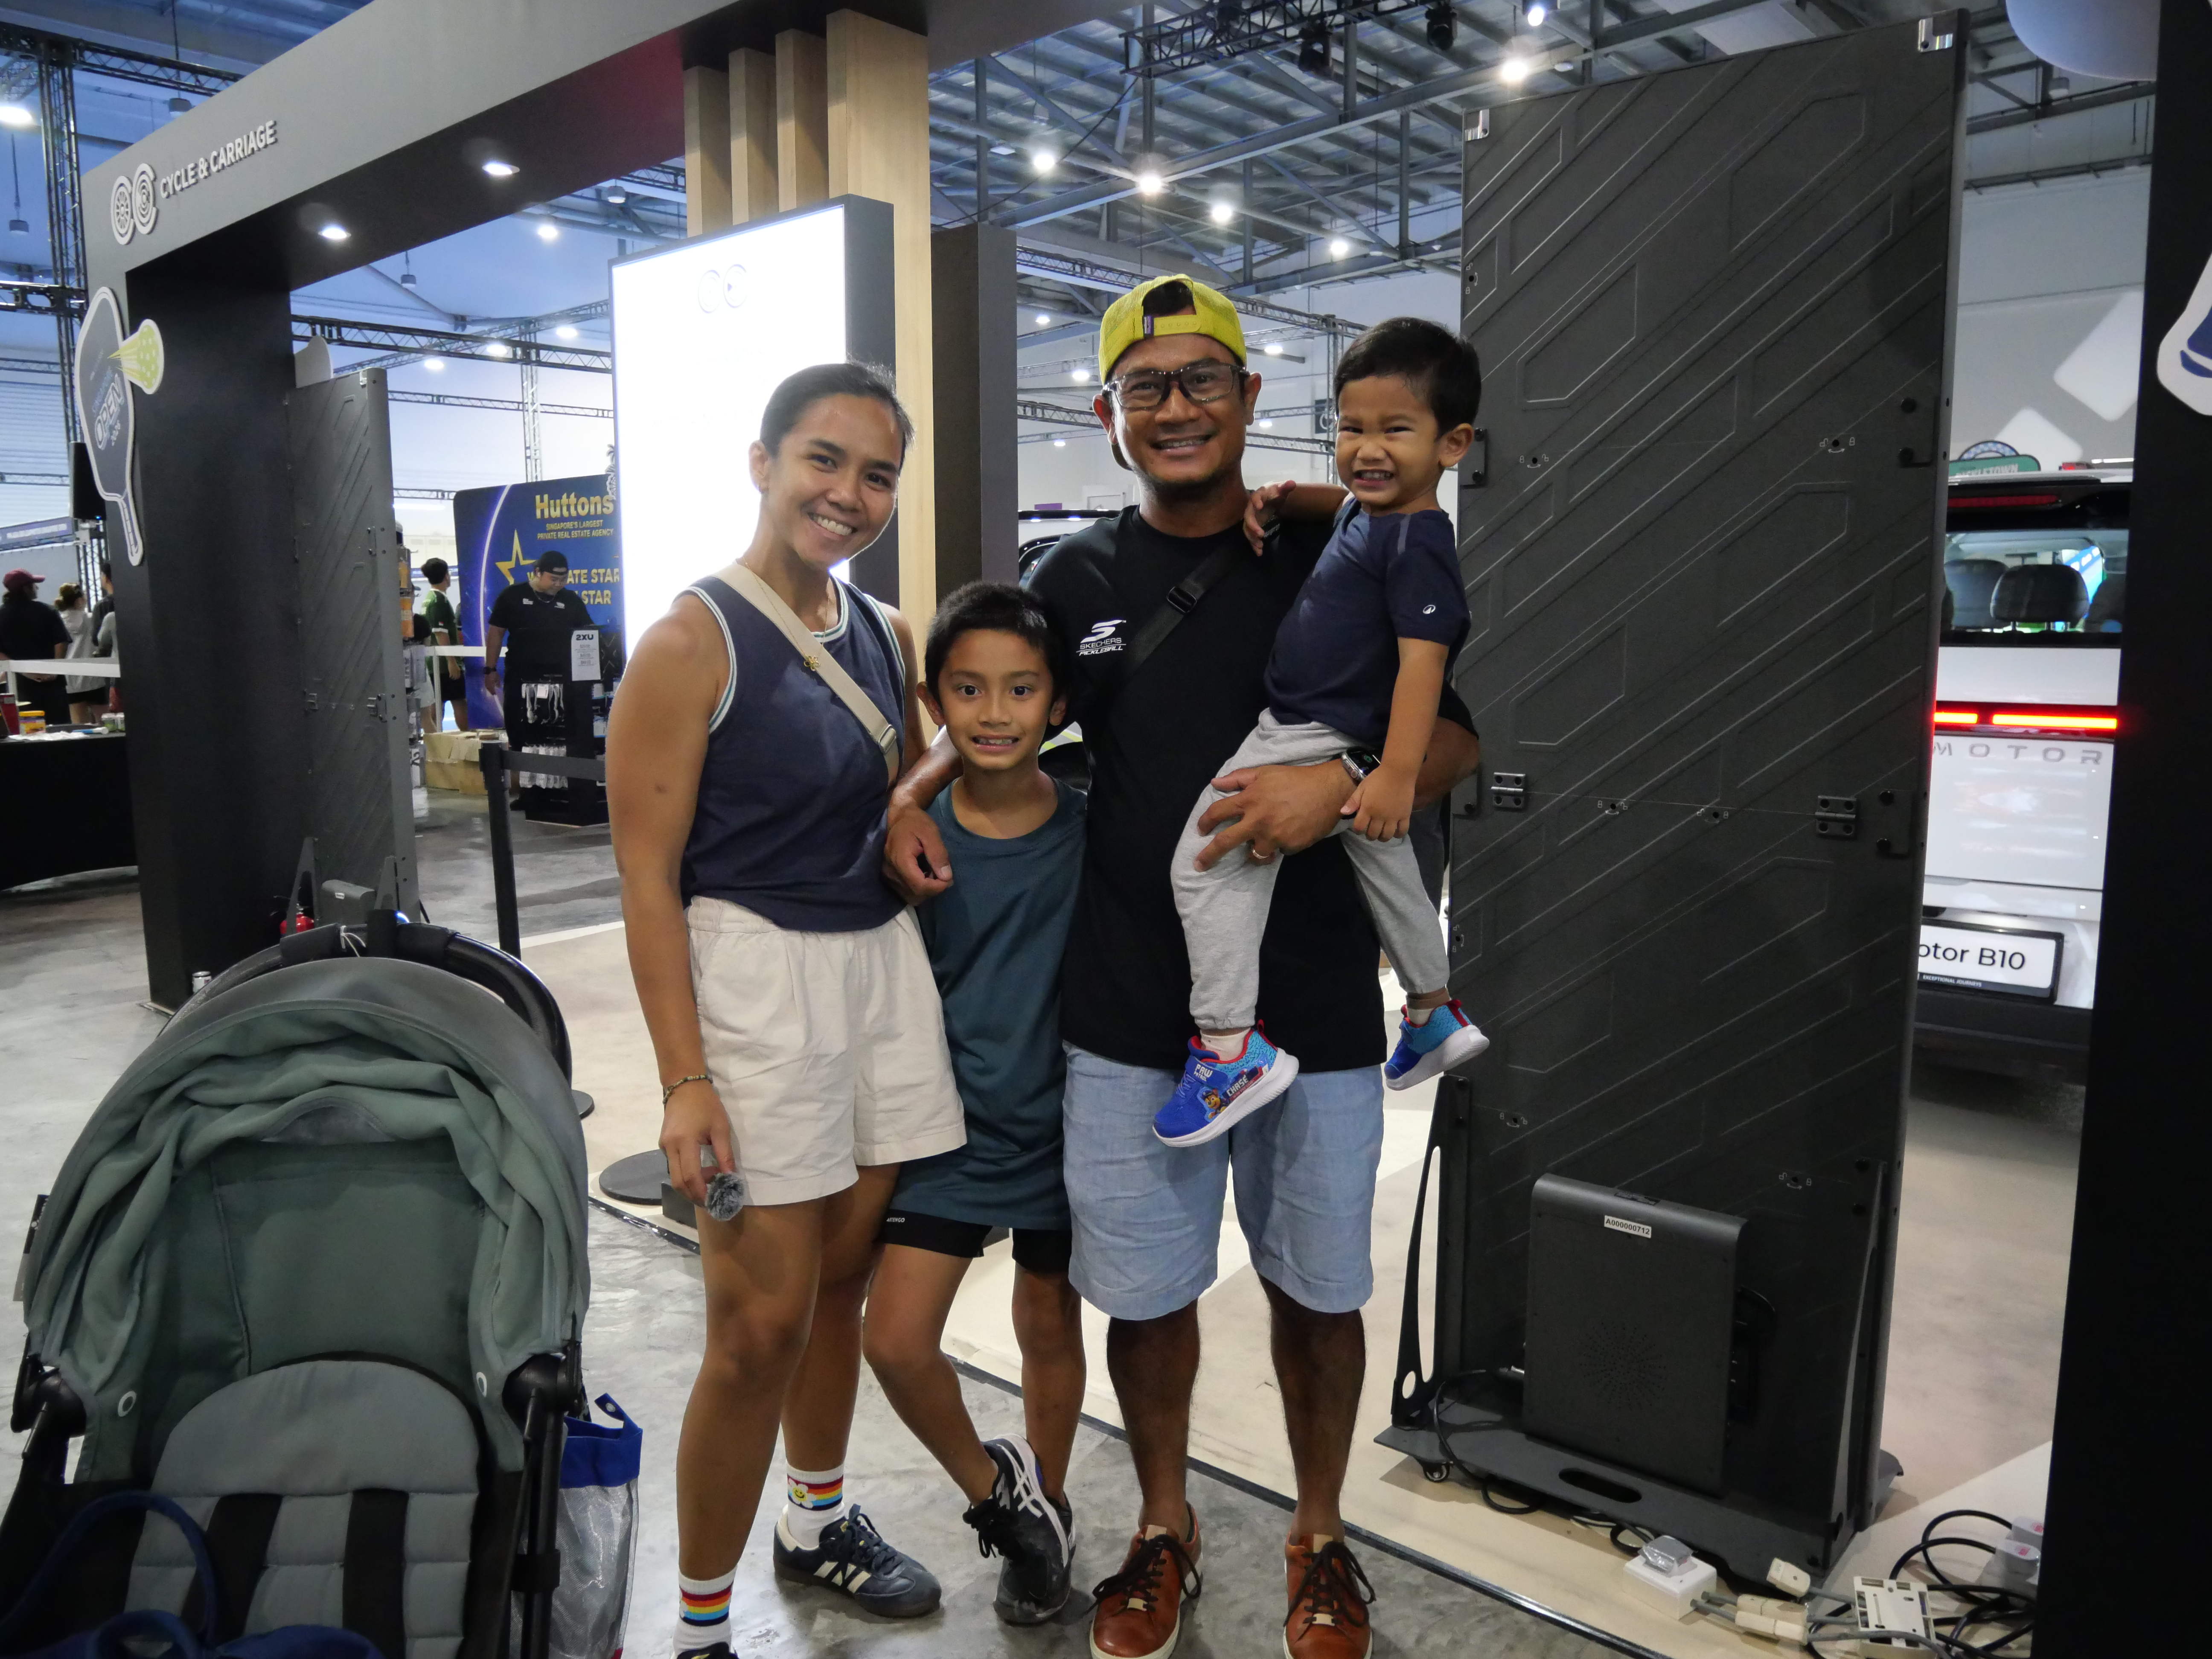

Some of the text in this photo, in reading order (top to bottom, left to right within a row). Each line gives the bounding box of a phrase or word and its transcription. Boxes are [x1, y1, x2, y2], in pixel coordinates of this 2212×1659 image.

[160, 120, 276, 198] CYCLE & CARRIAGE
[95, 373, 125, 451] OPEN
[535, 492, 614, 519] Huttons
[546, 520, 604, 531] SINGAPORE'S LARGEST
[558, 531, 570, 539] REAL
[571, 530, 591, 538] ESTATE
[592, 528, 614, 537] AGENCY
[567, 569, 588, 584] ATE
[581, 590, 612, 605] STAR
[1080, 637, 1122, 649] SKECHERS
[1079, 646, 1123, 656] PICKLEBALL
[1919, 943, 2026, 970] otor B10
[1923, 975, 1982, 988] EXCEPTIONAL JOURNEYS
[1193, 1071, 1207, 1082] PATROL
[1195, 1064, 1213, 1078] PAW
[1226, 1074, 1249, 1097] CHASE
[1606, 1218, 1650, 1235] A000000712
